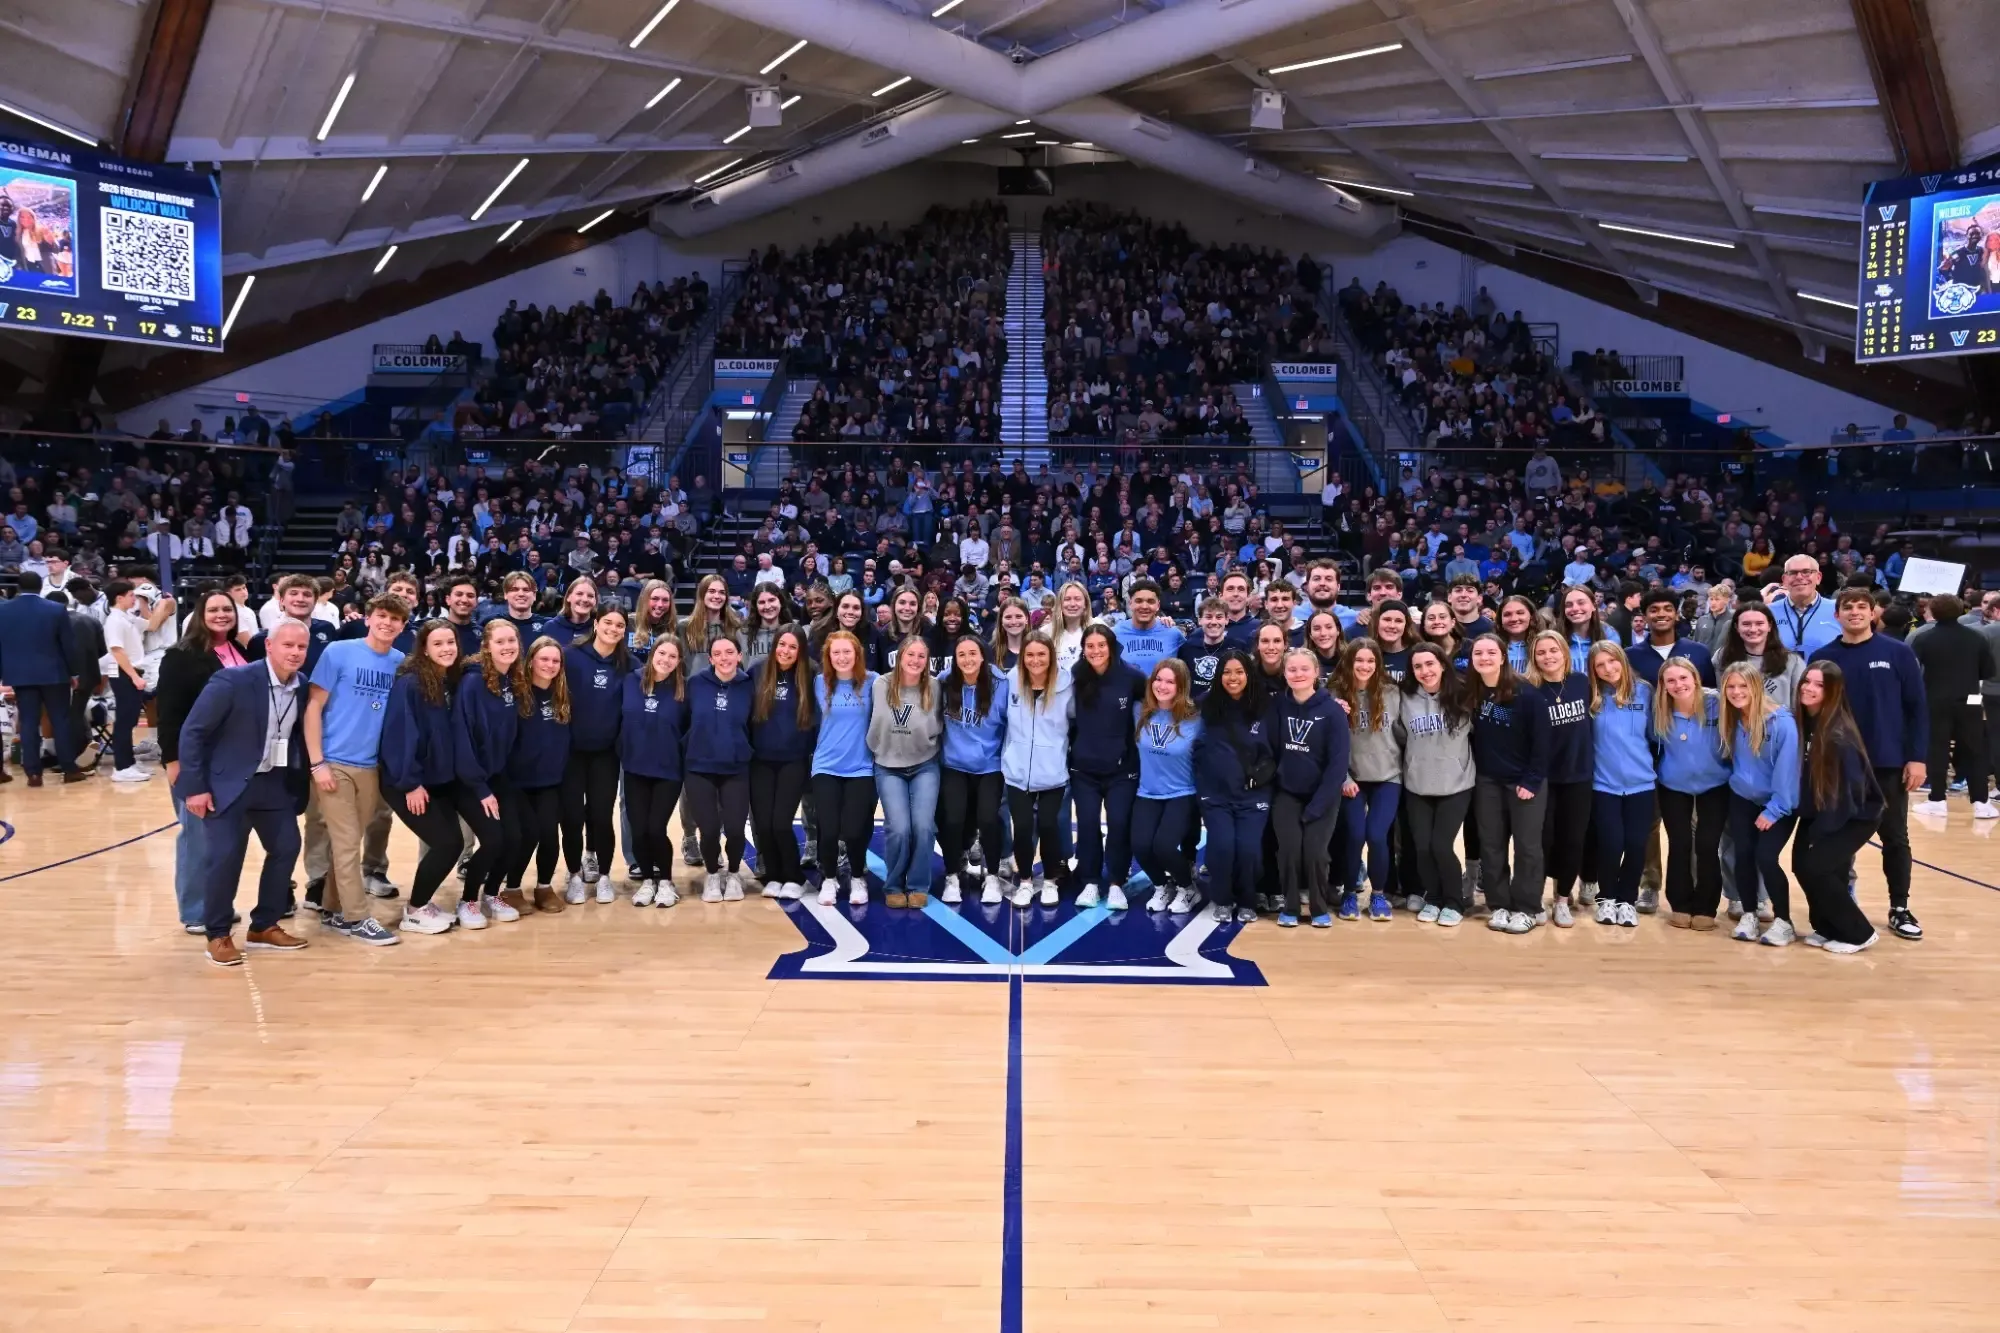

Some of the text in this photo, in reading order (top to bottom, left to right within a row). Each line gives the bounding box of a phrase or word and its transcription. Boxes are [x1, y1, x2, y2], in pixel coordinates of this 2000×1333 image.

[0, 142, 72, 164] COLEMAN
[99, 161, 124, 173] VIDEO
[120, 185, 155, 200] FREEDOM
[155, 192, 195, 208] MORTGAGE
[110, 193, 189, 220] WILDCAT WALL
[1879, 204, 1898, 221] V
[1939, 204, 1971, 219] WILDCATS
[1870, 228, 1905, 240] 2 3 0
[1870, 241, 1877, 249] 5
[1898, 237, 1904, 246] 1
[1869, 247, 1903, 260] 7 3 1
[1884, 259, 1891, 267] 2
[1897, 257, 1903, 265] 0
[1884, 268, 1890, 277] 2
[1897, 267, 1902, 275] 1
[124, 293, 180, 307] ENTER TO WIN
[16, 306, 37, 321] 23
[1866, 308, 1873, 317] 0
[1894, 305, 1901, 313] 0
[61, 311, 95, 328] 7:22
[107, 321, 114, 331] 1
[1866, 318, 1873, 326] 2
[1895, 315, 1900, 323] 1
[139, 321, 157, 335] 17
[1864, 328, 1875, 336] 10
[1894, 325, 1900, 333] 0
[191, 334, 213, 344] FLS 3
[1863, 337, 1874, 346] 12
[1893, 335, 1899, 343] 2
[1950, 329, 1970, 347] V
[1977, 329, 1997, 343] 23
[1863, 347, 1874, 355] 13
[1910, 341, 1934, 351] FLS 3
[1281, 365, 1332, 375] COLOMBE
[1614, 381, 1682, 393] COLOMBE
[1126, 638, 1164, 654] VILLANOVA
[891, 703, 915, 728] V
[1548, 698, 1586, 721] ILDCATS
[1150, 722, 1175, 749] V
[1287, 716, 1314, 744] V
